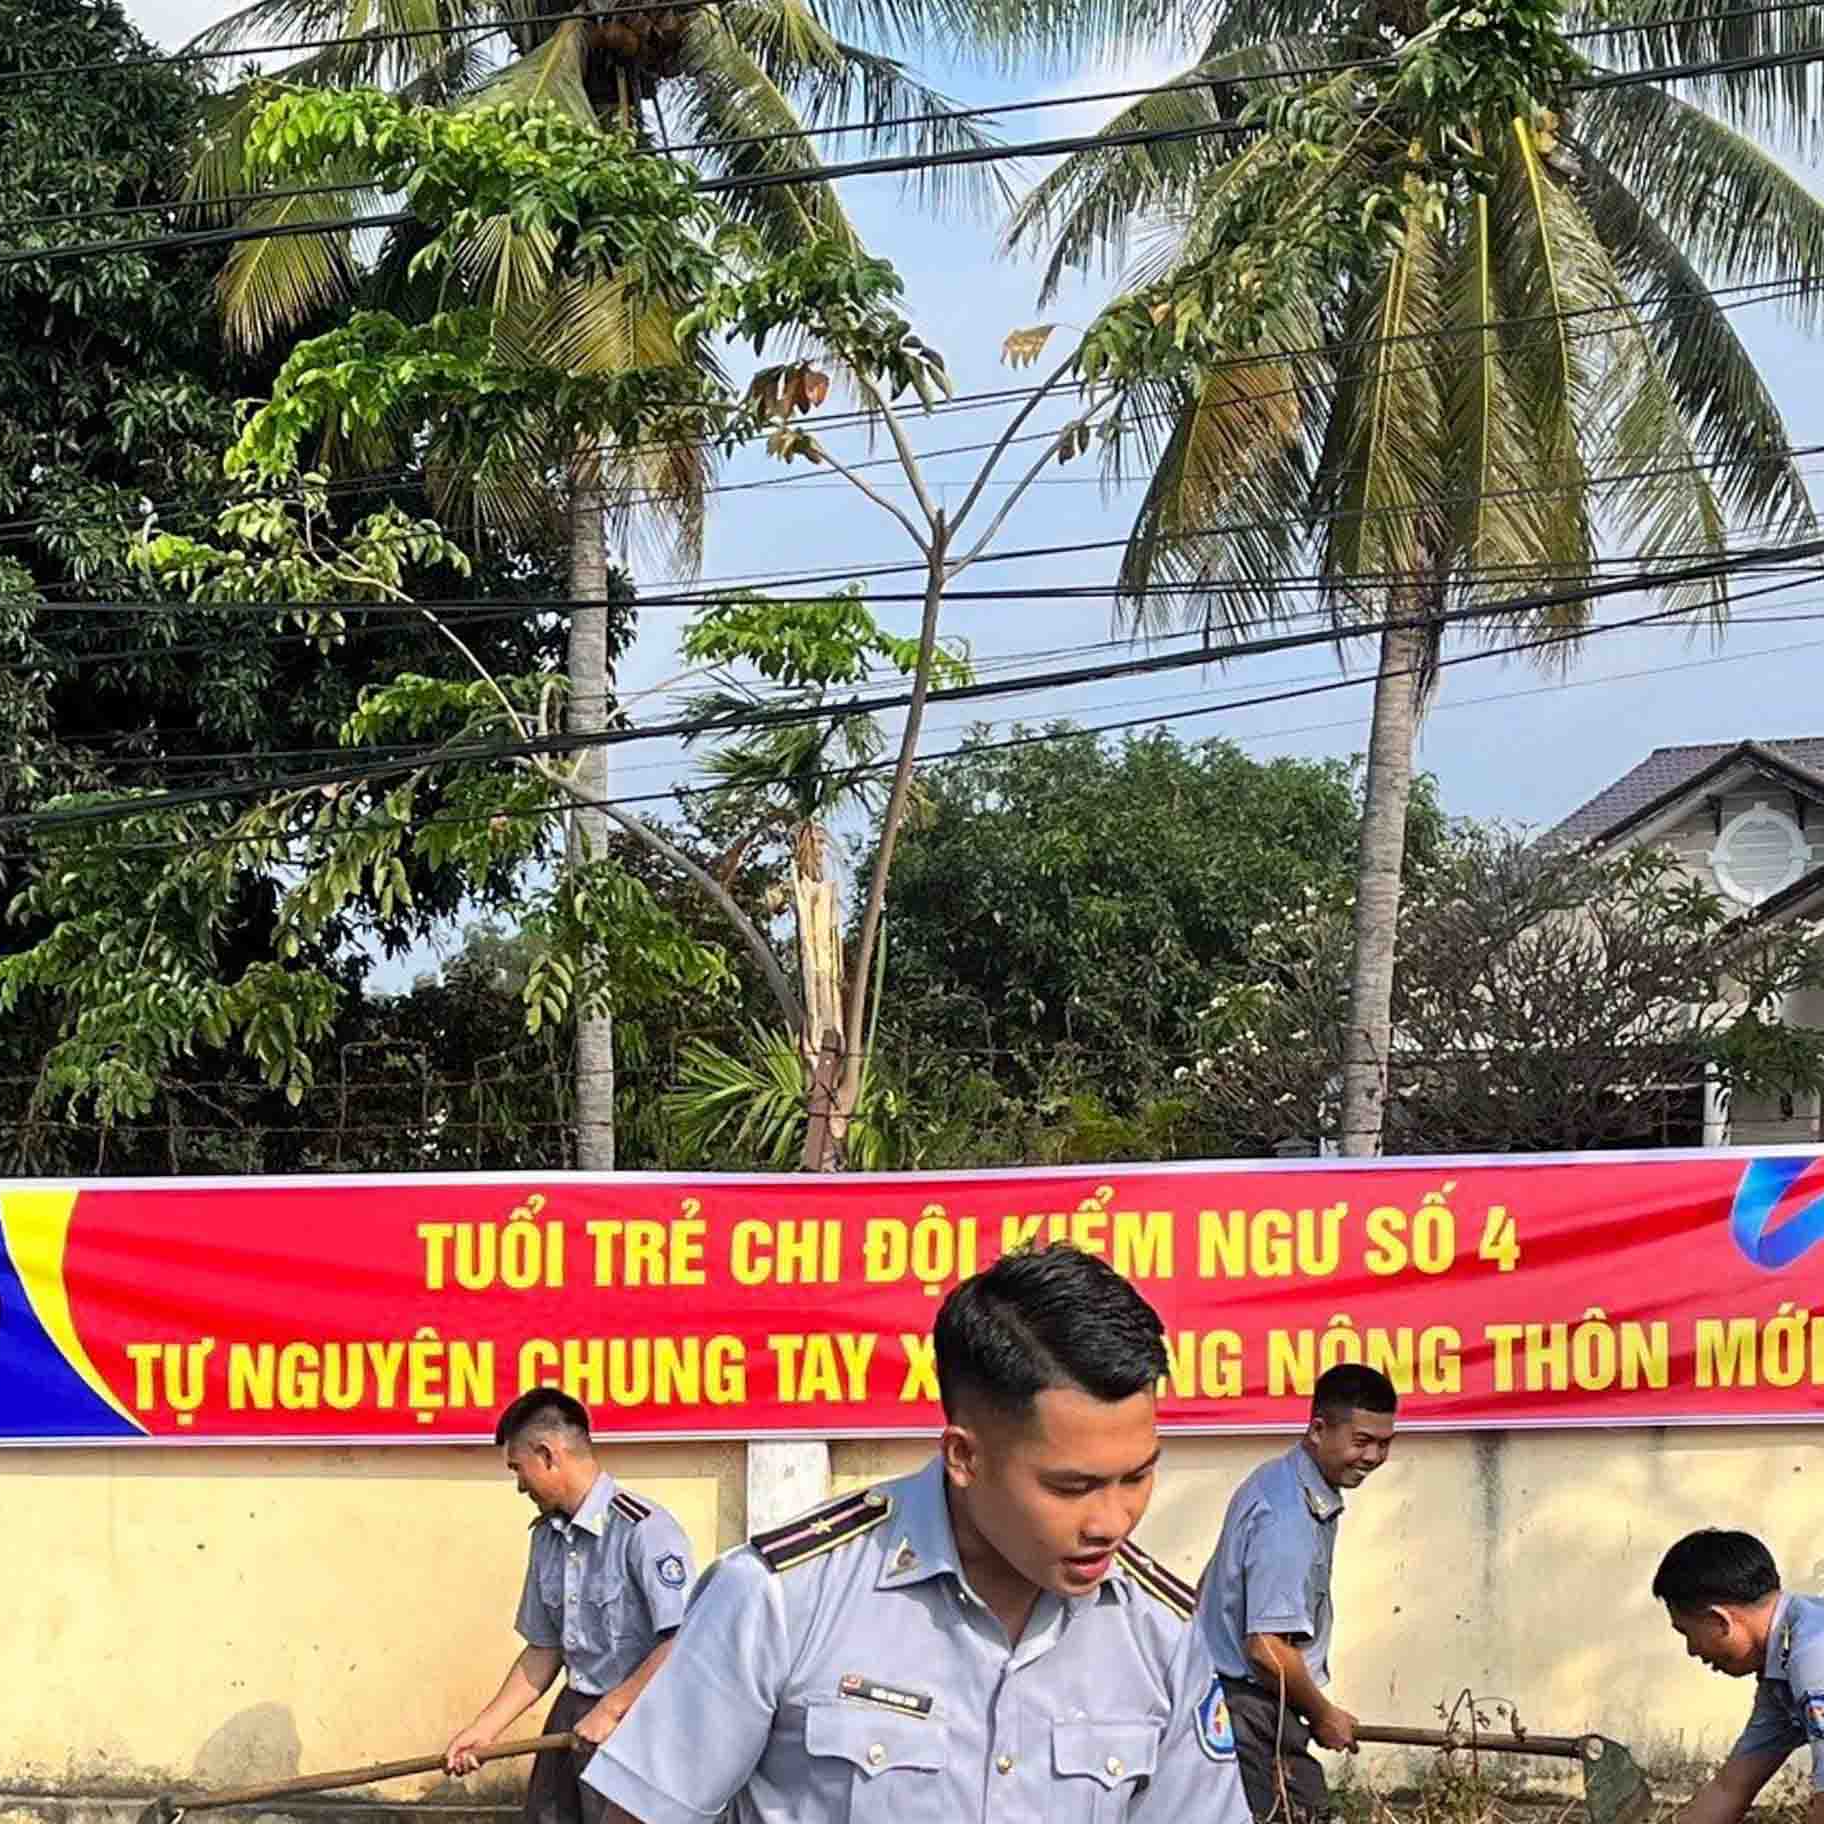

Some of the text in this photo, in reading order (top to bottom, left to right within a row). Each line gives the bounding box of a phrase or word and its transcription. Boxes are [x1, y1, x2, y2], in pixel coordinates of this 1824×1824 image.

[417, 1194, 564, 1290] TUỔI
[589, 1199, 707, 1287] TRẺ
[730, 1219, 842, 1286] CHI
[862, 1203, 977, 1297] ĐỘI
[1198, 1206, 1349, 1280] NGƯ
[1365, 1181, 1457, 1275] SỐ
[1479, 1206, 1521, 1272] 4
[127, 1336, 216, 1425] TỰ
[228, 1326, 496, 1423] NGUYỆN
[518, 1335, 747, 1407] CHUNG
[767, 1333, 876, 1402] TAY
[1268, 1313, 1462, 1397] NÔNG
[1486, 1307, 1669, 1392] THÔN
